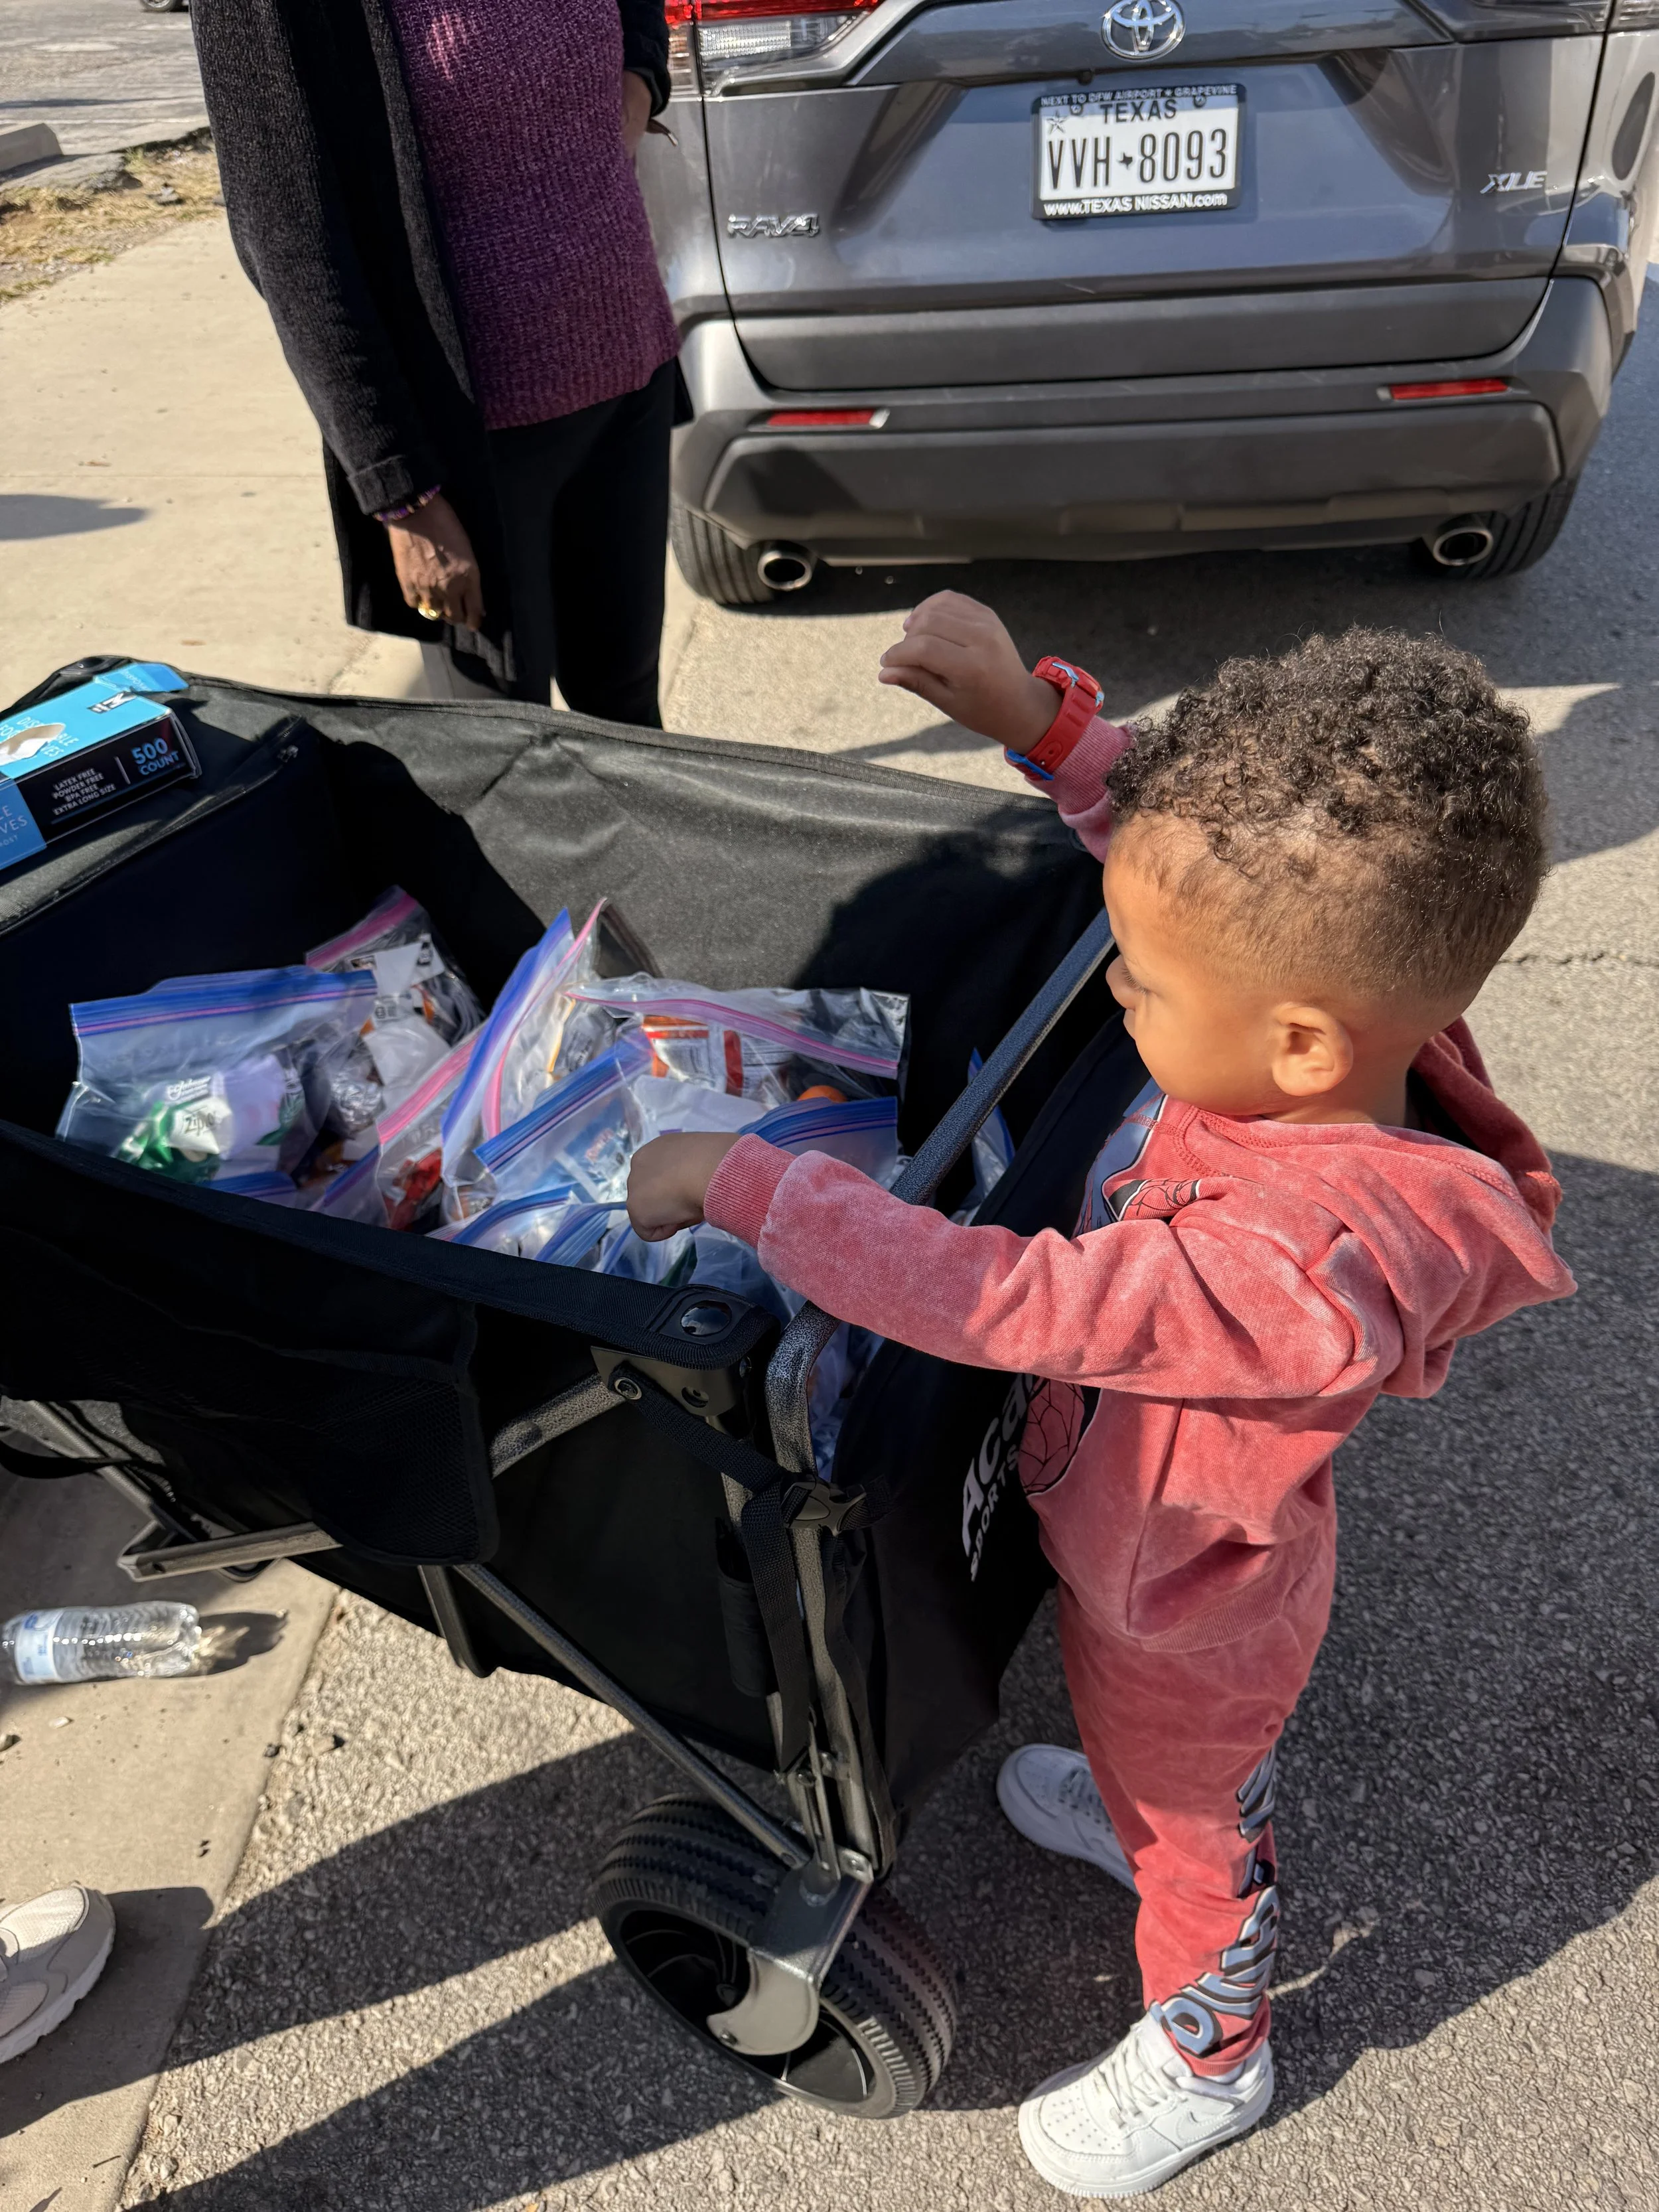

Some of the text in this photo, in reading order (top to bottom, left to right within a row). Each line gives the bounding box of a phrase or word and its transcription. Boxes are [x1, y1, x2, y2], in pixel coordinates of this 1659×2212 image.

[1041, 84, 1237, 107] NEXT TO DFW AIRPORT GRAPEVINE
[1100, 100, 1177, 123] TEXAS
[1048, 128, 1227, 190] VVH 8093
[1480, 171, 1548, 194] XLE
[728, 214, 819, 238] RAV4
[131, 737, 168, 765] 500
[139, 750, 179, 776] COUNT
[52, 773, 104, 799] POWDER FREE
[54, 768, 96, 791] LATEX FREE
[80, 784, 99, 796] FREE
[53, 783, 116, 816] EXTRA LONG SIZE
[971, 1444, 1020, 1582] SPORTS
